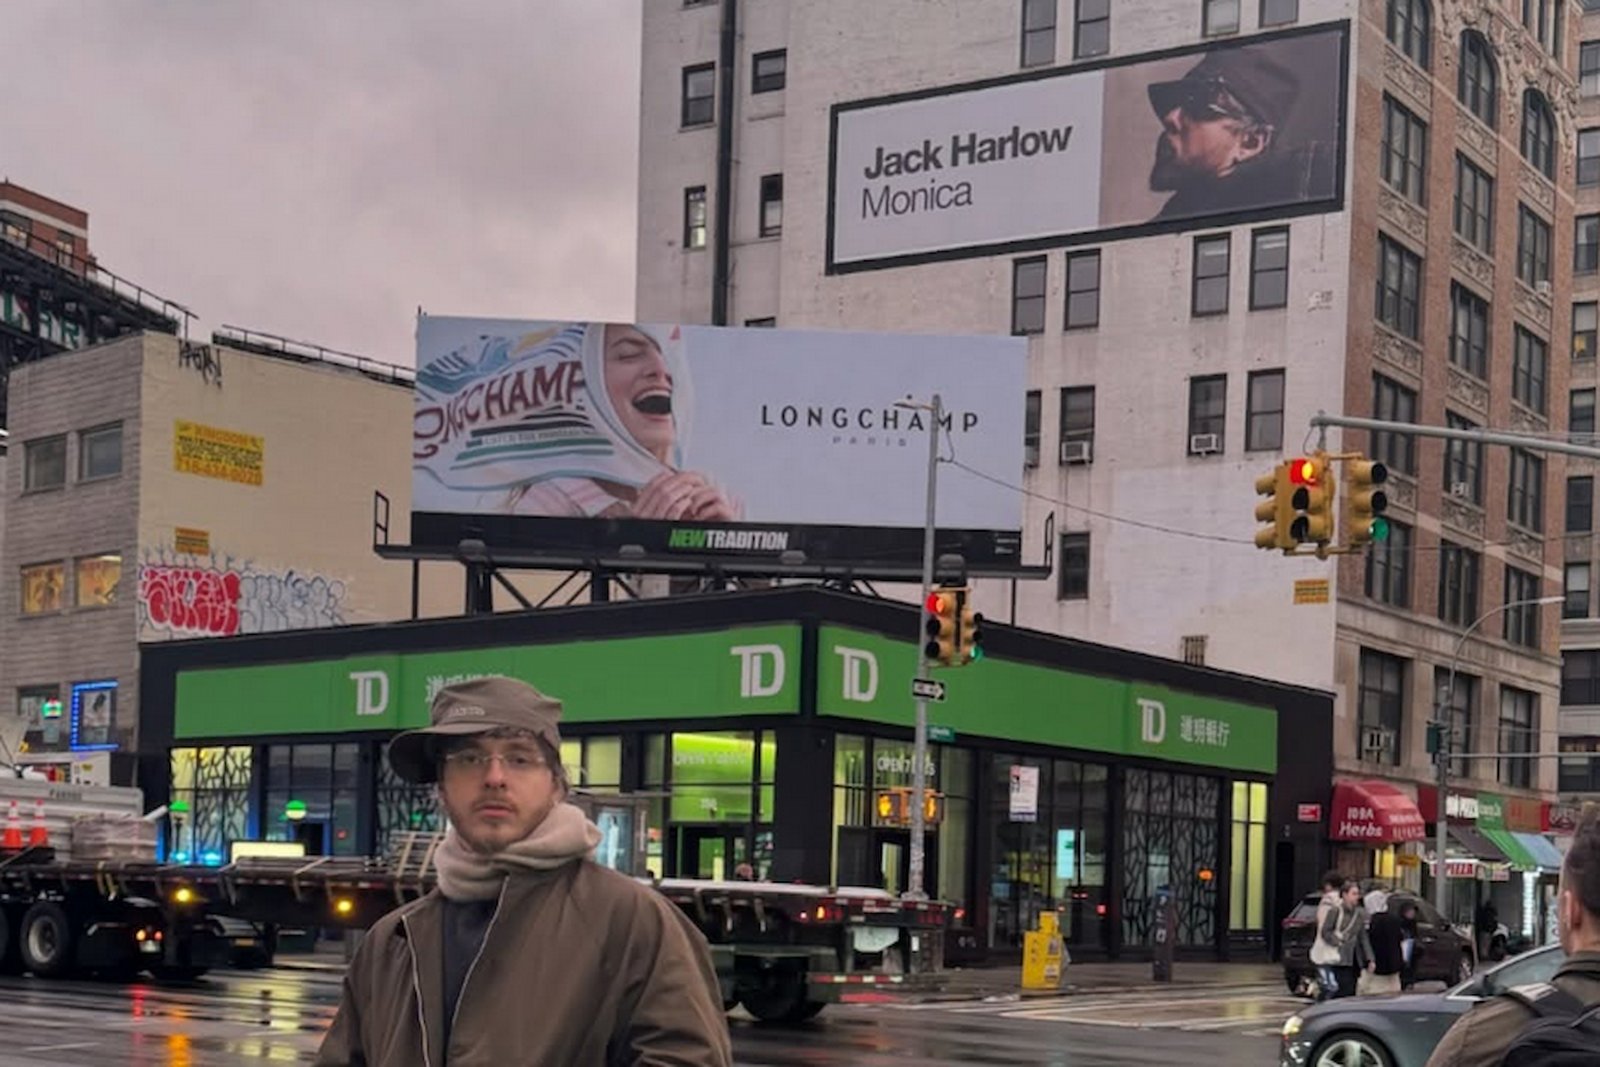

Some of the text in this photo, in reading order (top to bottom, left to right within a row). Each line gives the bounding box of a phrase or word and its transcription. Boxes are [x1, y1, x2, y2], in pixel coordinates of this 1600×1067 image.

[864, 125, 1073, 179] Jack Harlow
[861, 178, 973, 219] Monica
[761, 404, 979, 433] LONGCHAMP
[349, 670, 389, 716] TD
[730, 643, 786, 698] TD
[834, 645, 879, 702] TD
[1136, 698, 1166, 743] TD
[877, 756, 904, 773] OPEN
[1339, 822, 1384, 837] Herbs
